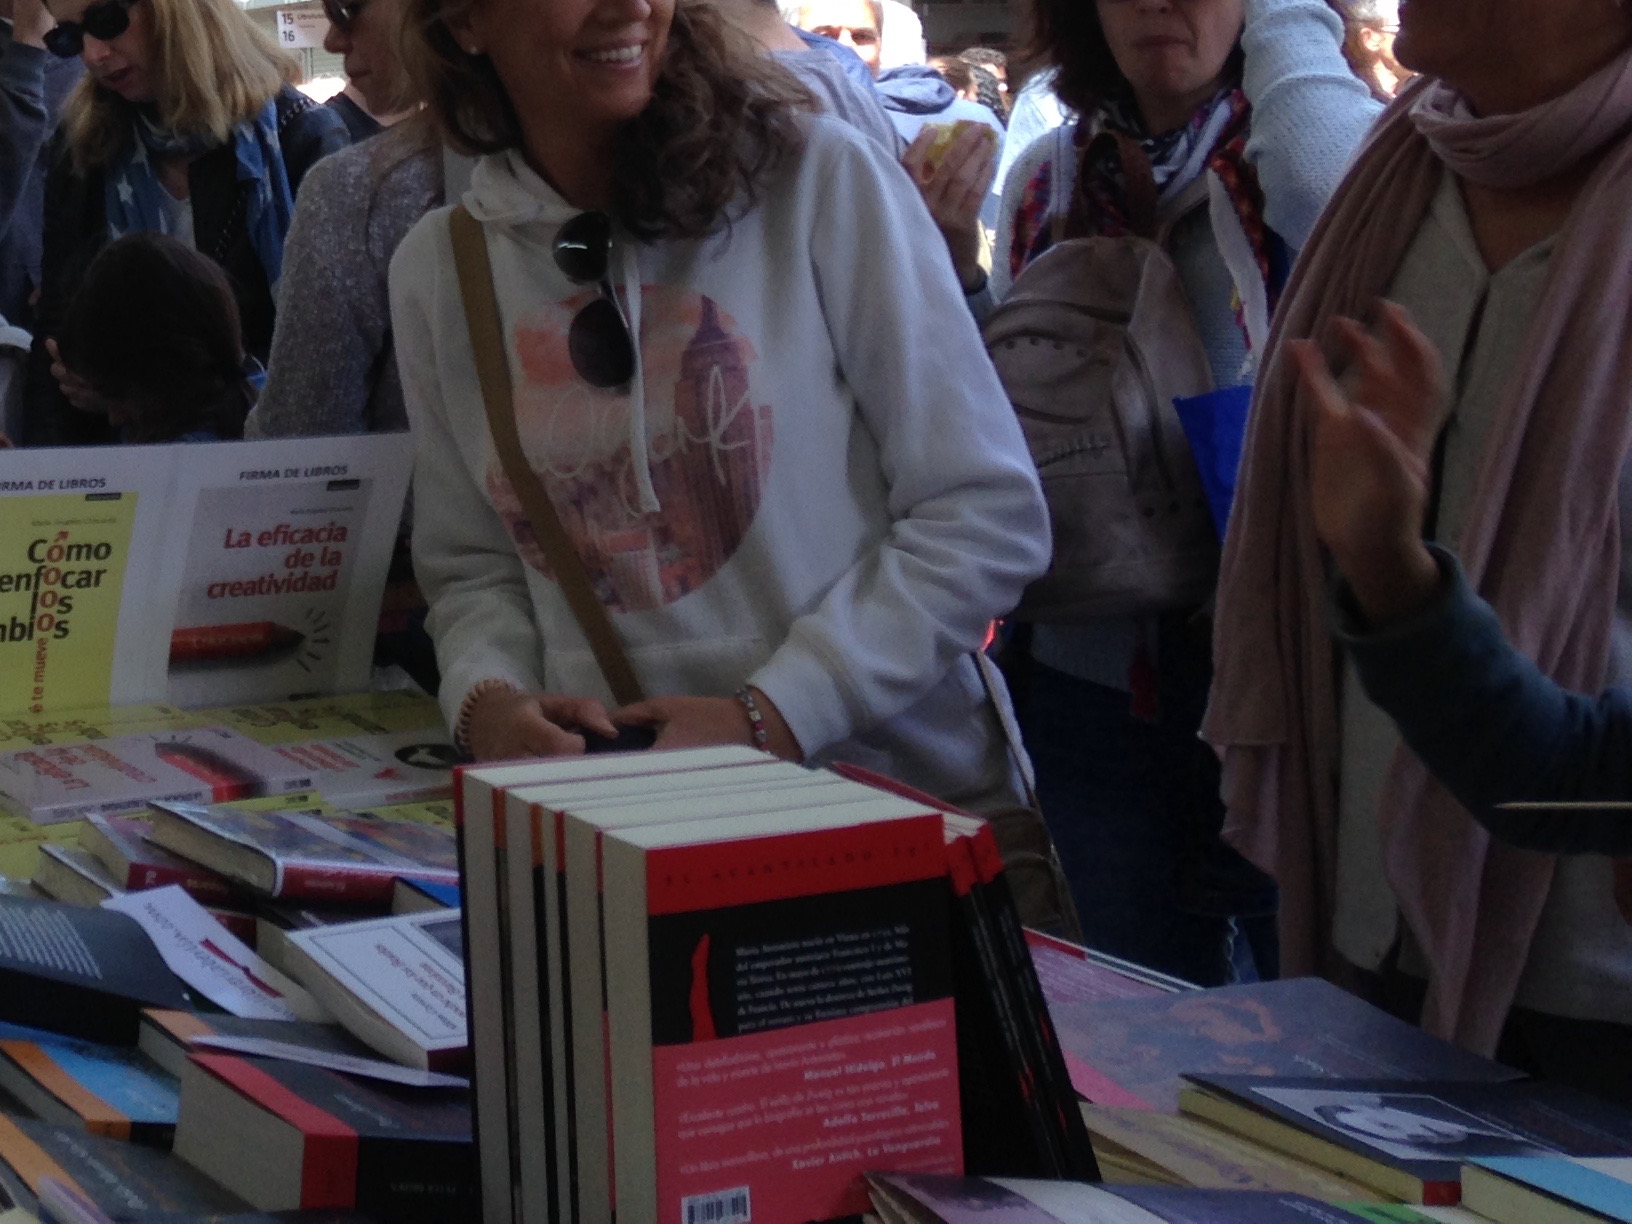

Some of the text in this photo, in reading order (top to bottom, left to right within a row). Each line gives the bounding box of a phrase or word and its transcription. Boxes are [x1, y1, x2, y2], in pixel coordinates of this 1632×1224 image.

[282, 13, 294, 25] 15
[282, 30, 295, 42] 16
[238, 464, 348, 480] FIRMA DE LIBROS
[37, 479, 55, 490] DE
[59, 477, 106, 490] LIBROS
[223, 521, 348, 549] La eficacia
[27, 531, 112, 564] Cómo
[284, 545, 343, 569] de la
[206, 570, 338, 599] creatividad
